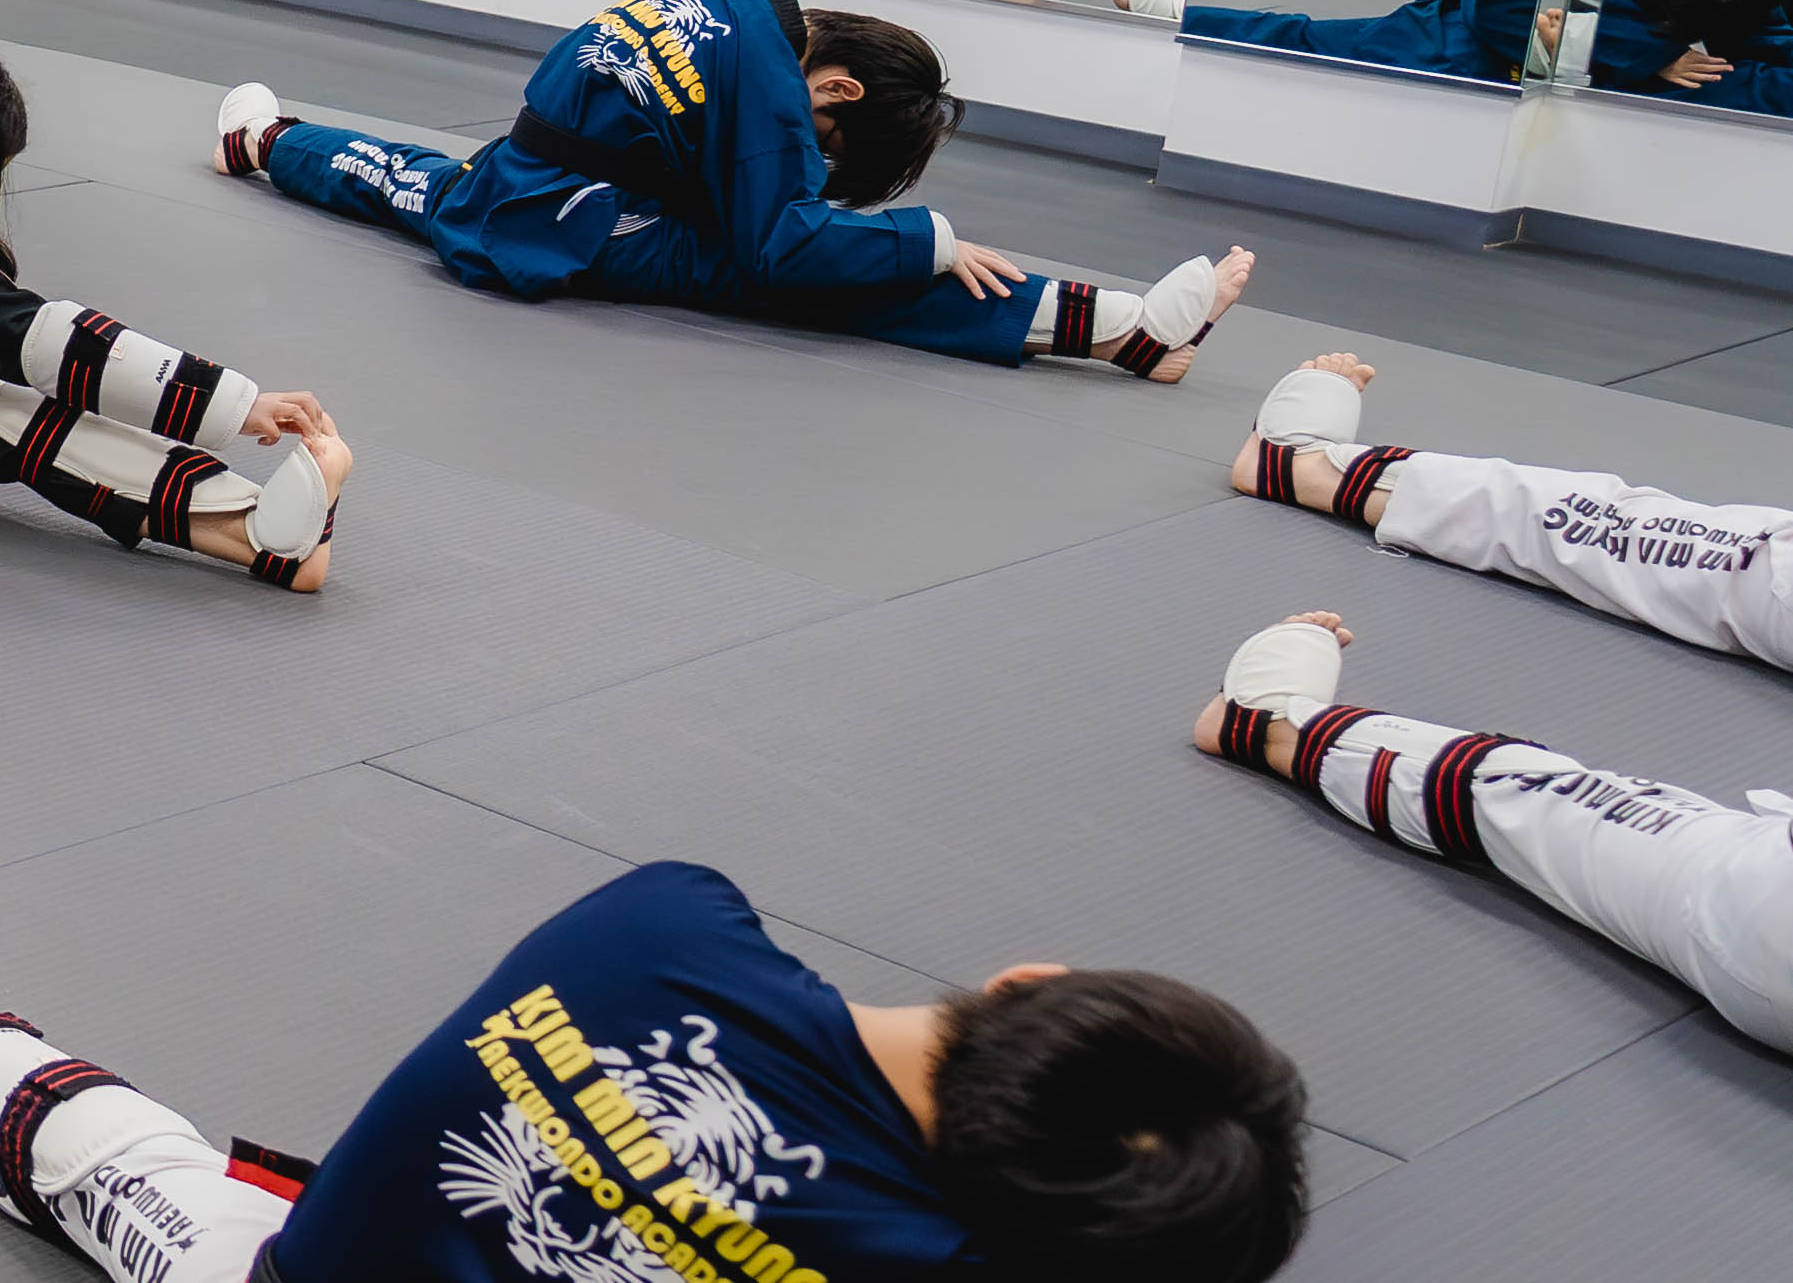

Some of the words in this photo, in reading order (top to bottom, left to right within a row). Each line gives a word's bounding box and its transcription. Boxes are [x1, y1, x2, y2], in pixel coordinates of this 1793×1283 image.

[1638, 537, 1694, 569] MIN
[465, 1008, 623, 1210] TAEKWONDO
[620, 1202, 733, 1283] ACAD
[507, 984, 592, 1083] KIM
[573, 1059, 671, 1182] MIN
